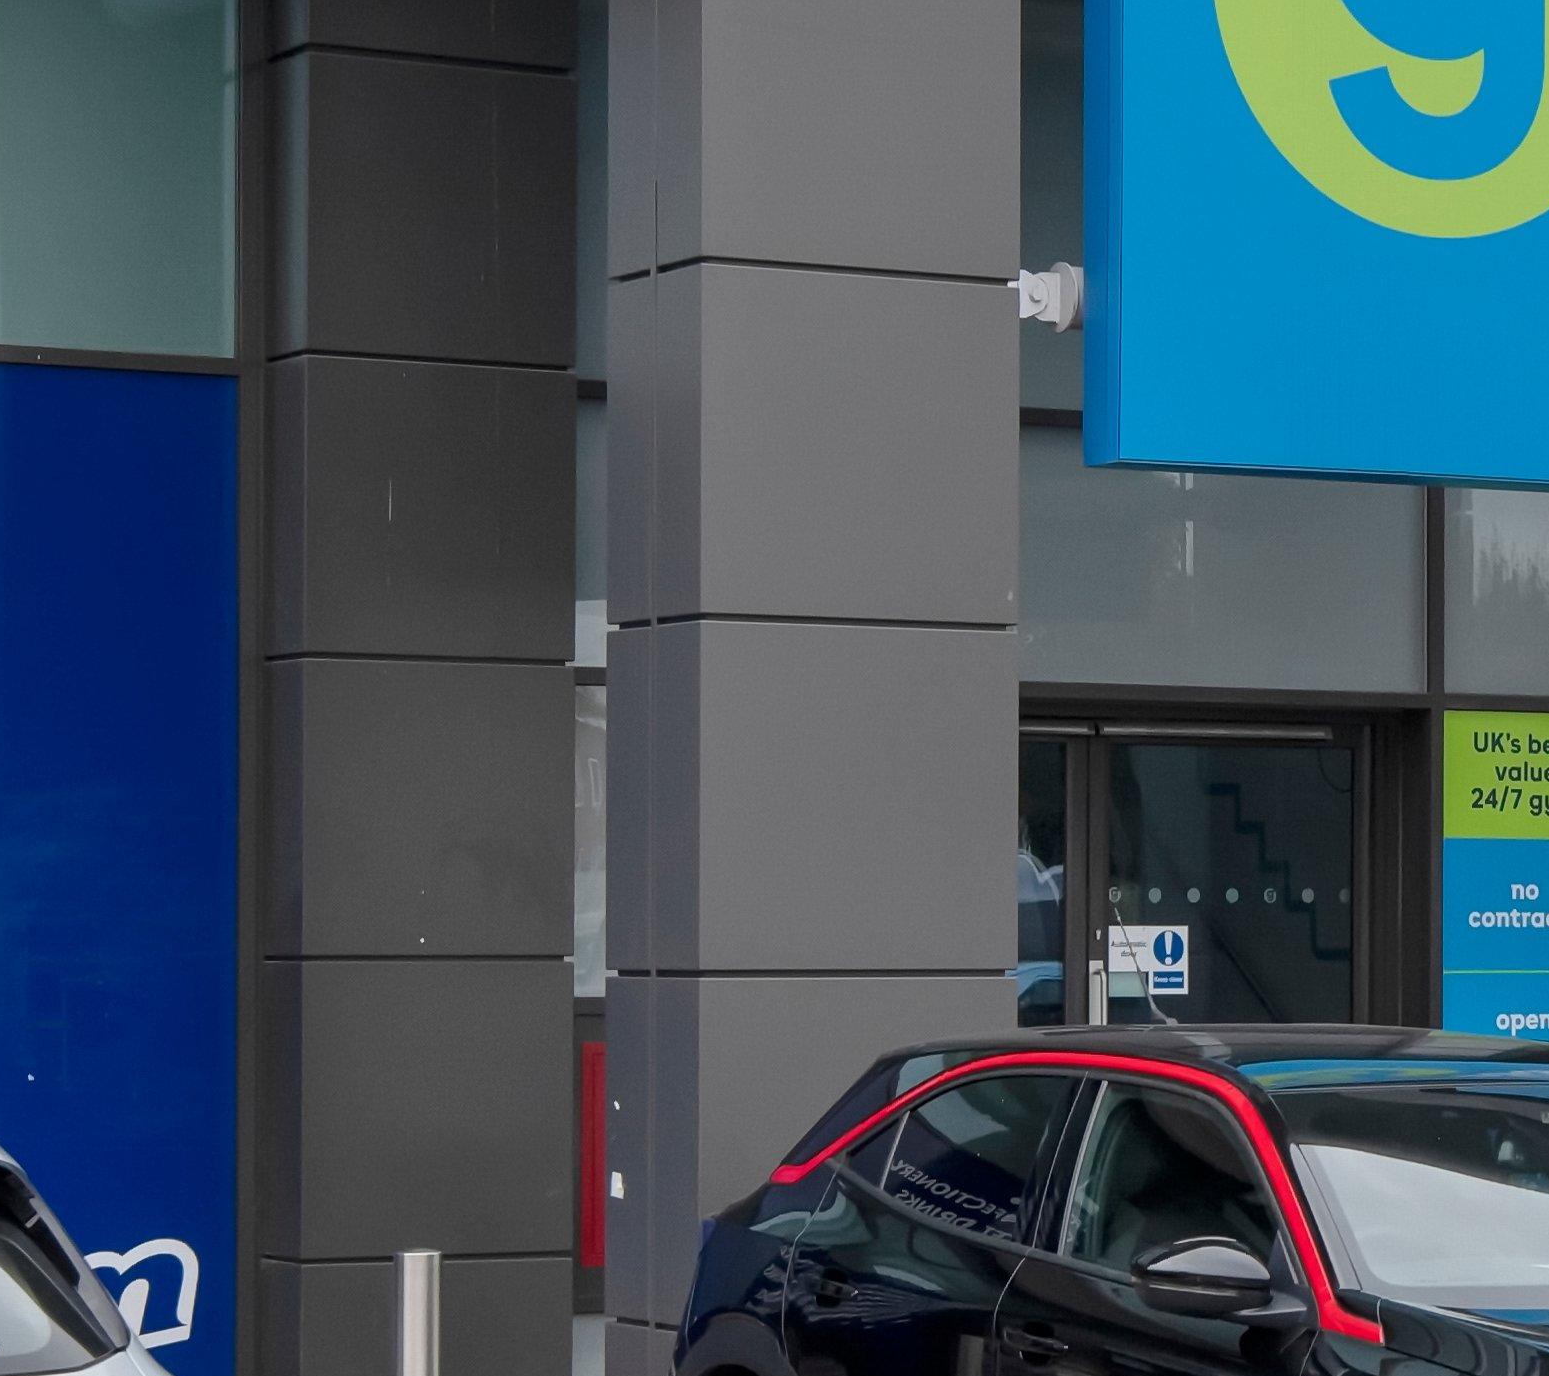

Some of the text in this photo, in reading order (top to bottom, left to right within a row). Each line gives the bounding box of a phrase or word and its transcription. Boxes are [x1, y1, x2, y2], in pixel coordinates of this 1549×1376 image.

[1473, 731, 1522, 756] UK's
[1471, 786, 1523, 813] 24/7
[1510, 882, 1540, 901] no
